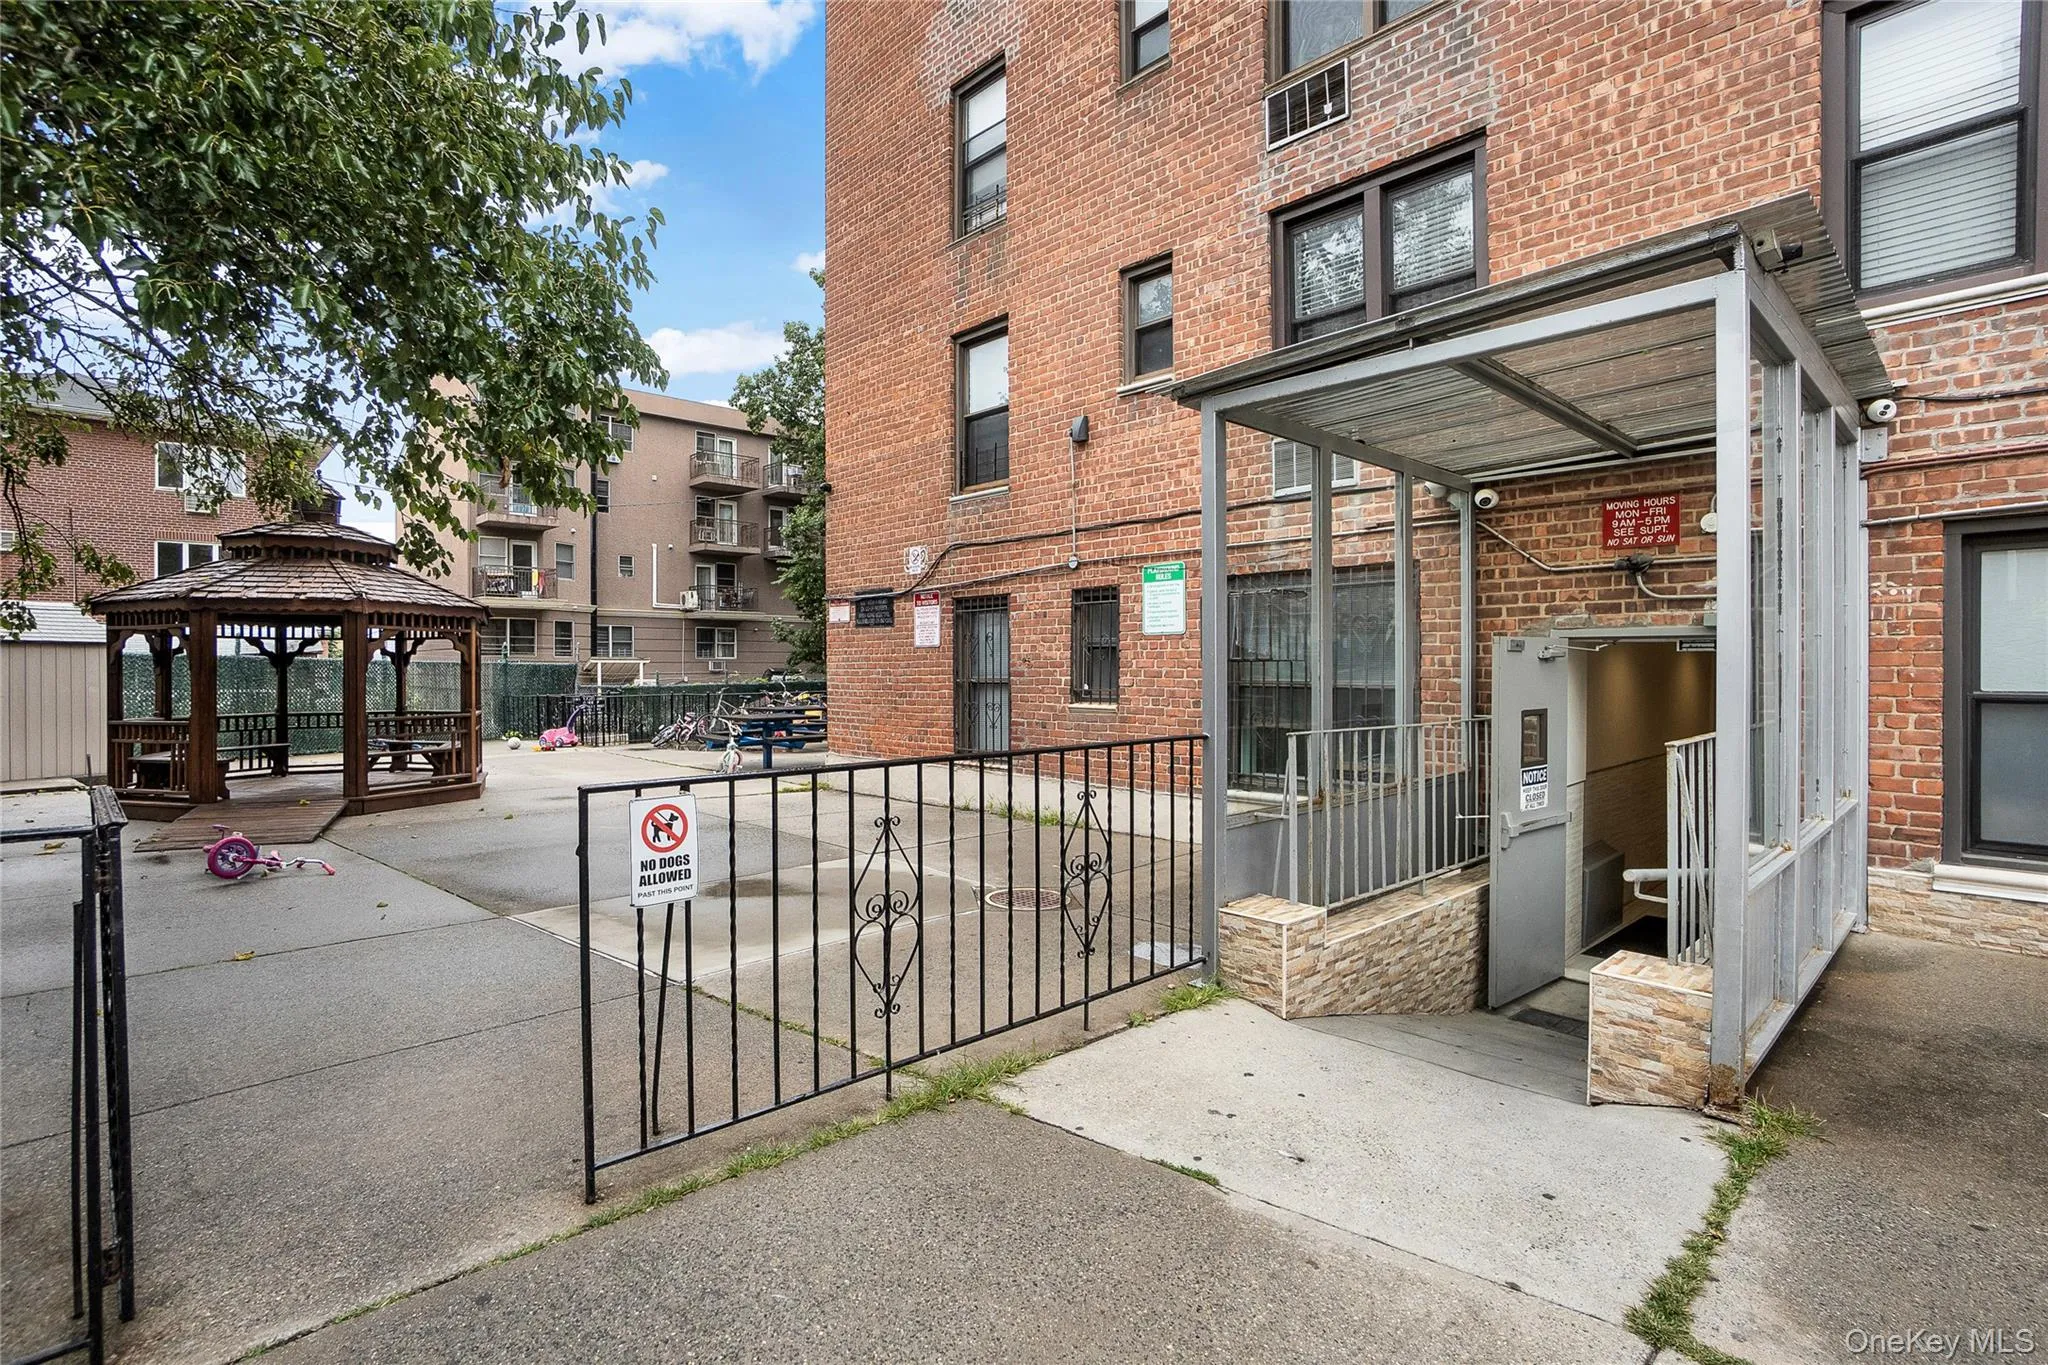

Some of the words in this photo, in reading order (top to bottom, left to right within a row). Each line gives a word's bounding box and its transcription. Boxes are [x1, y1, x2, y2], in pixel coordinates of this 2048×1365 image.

[1606, 500, 1639, 510] MOVING
[1643, 496, 1676, 507] HOURS
[1613, 528, 1635, 537] SEE
[1640, 525, 1669, 535] SUPT.
[1607, 538, 1619, 547] NO
[1622, 537, 1639, 546] SAT
[1641, 536, 1653, 544] OR
[1656, 534, 1676, 543] SUN
[1523, 769, 1547, 785] NOTICE
[1525, 791, 1546, 803] CLOSED
[640, 859, 656, 872] NO
[659, 854, 690, 869] DOGS
[639, 868, 692, 887] ALLOWED
[637, 890, 656, 898] PAST
[657, 887, 673, 896] THIS
[673, 884, 694, 893] POINT
